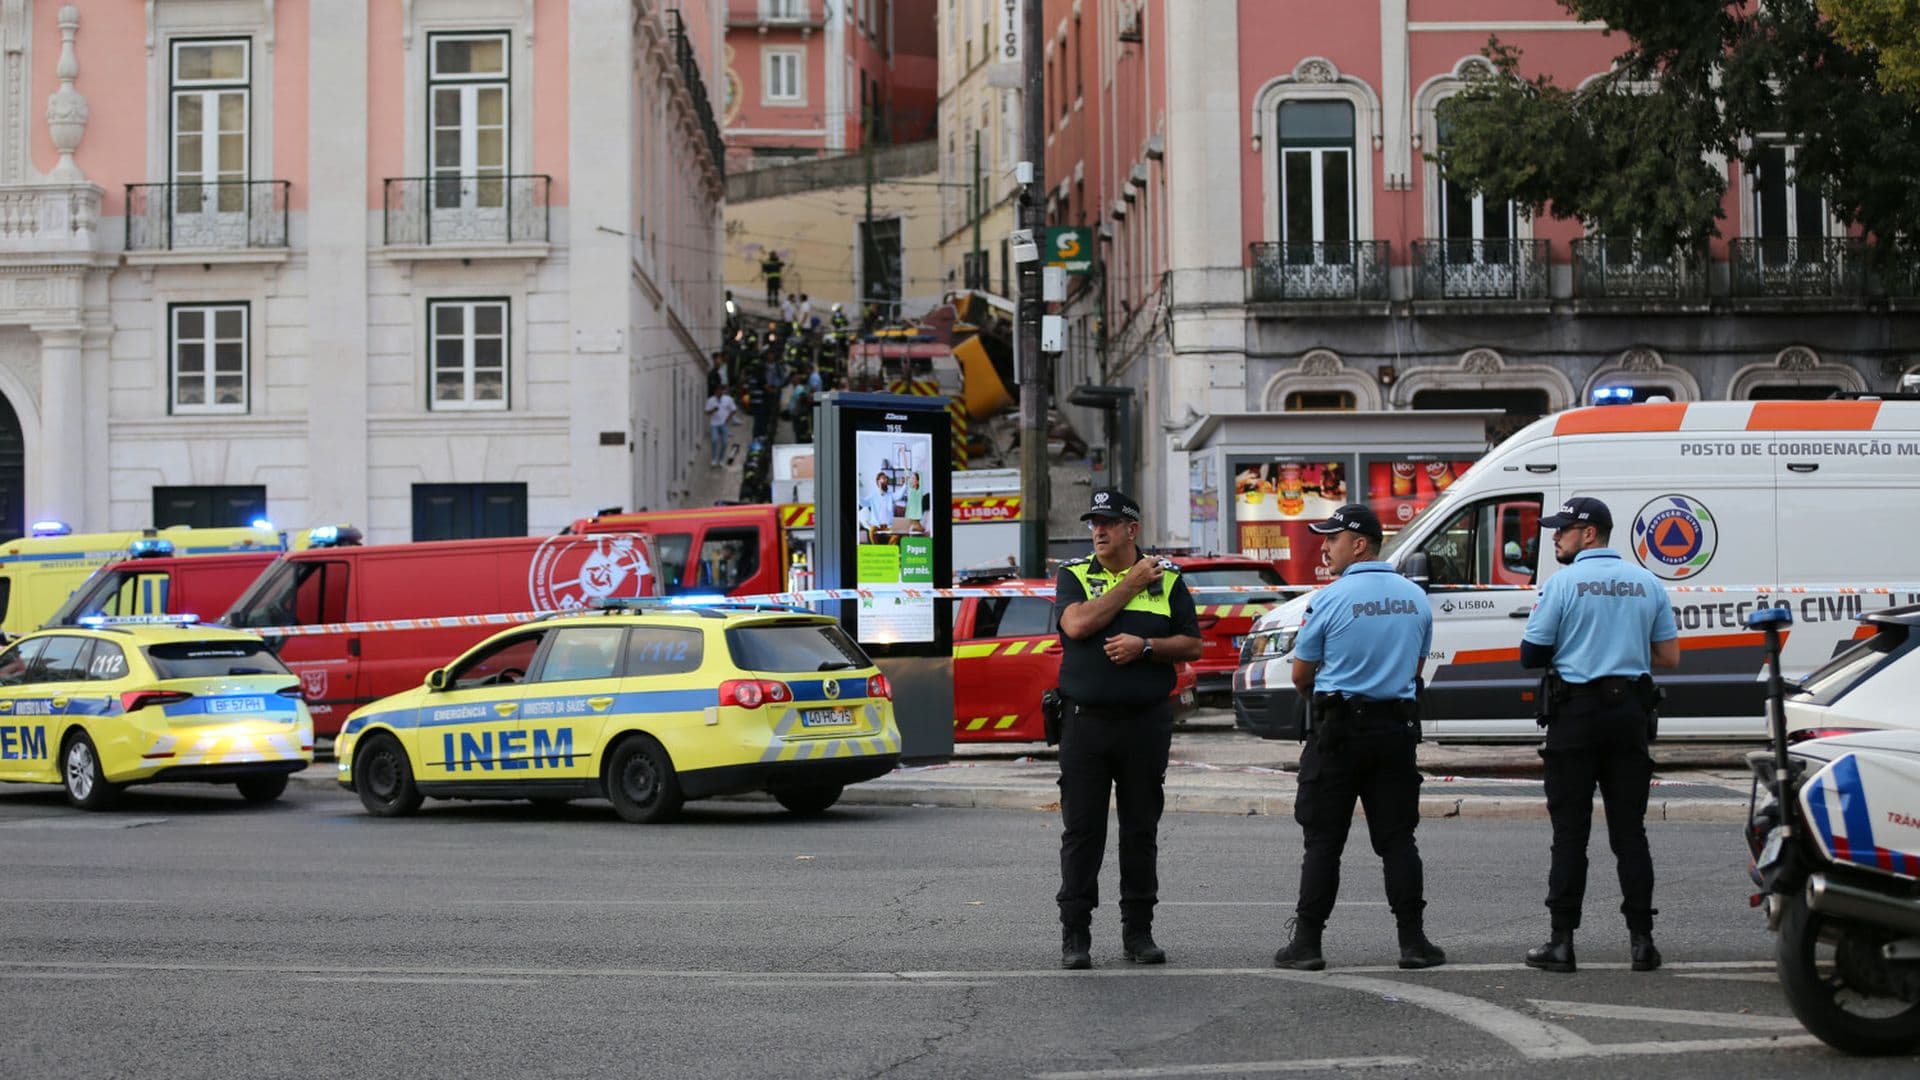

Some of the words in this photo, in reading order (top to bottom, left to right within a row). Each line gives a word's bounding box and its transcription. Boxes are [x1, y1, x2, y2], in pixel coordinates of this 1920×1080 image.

[1680, 443, 1736, 456] POSTO
[1741, 443, 1762, 456] DE
[1767, 439, 1892, 457] COORDENAÇÃO
[1897, 443, 1920, 456] MU
[963, 507, 1009, 517] LISBOA
[906, 545, 927, 555] Pague
[904, 567, 915, 576] por
[1576, 579, 1647, 597] POLÍCIA
[1352, 597, 1419, 618] POLÍCIA
[1458, 600, 1495, 610] LISBOA
[653, 640, 689, 662] 112
[97, 655, 124, 673] 112
[0, 726, 48, 760] EM
[443, 727, 574, 772] INEM
